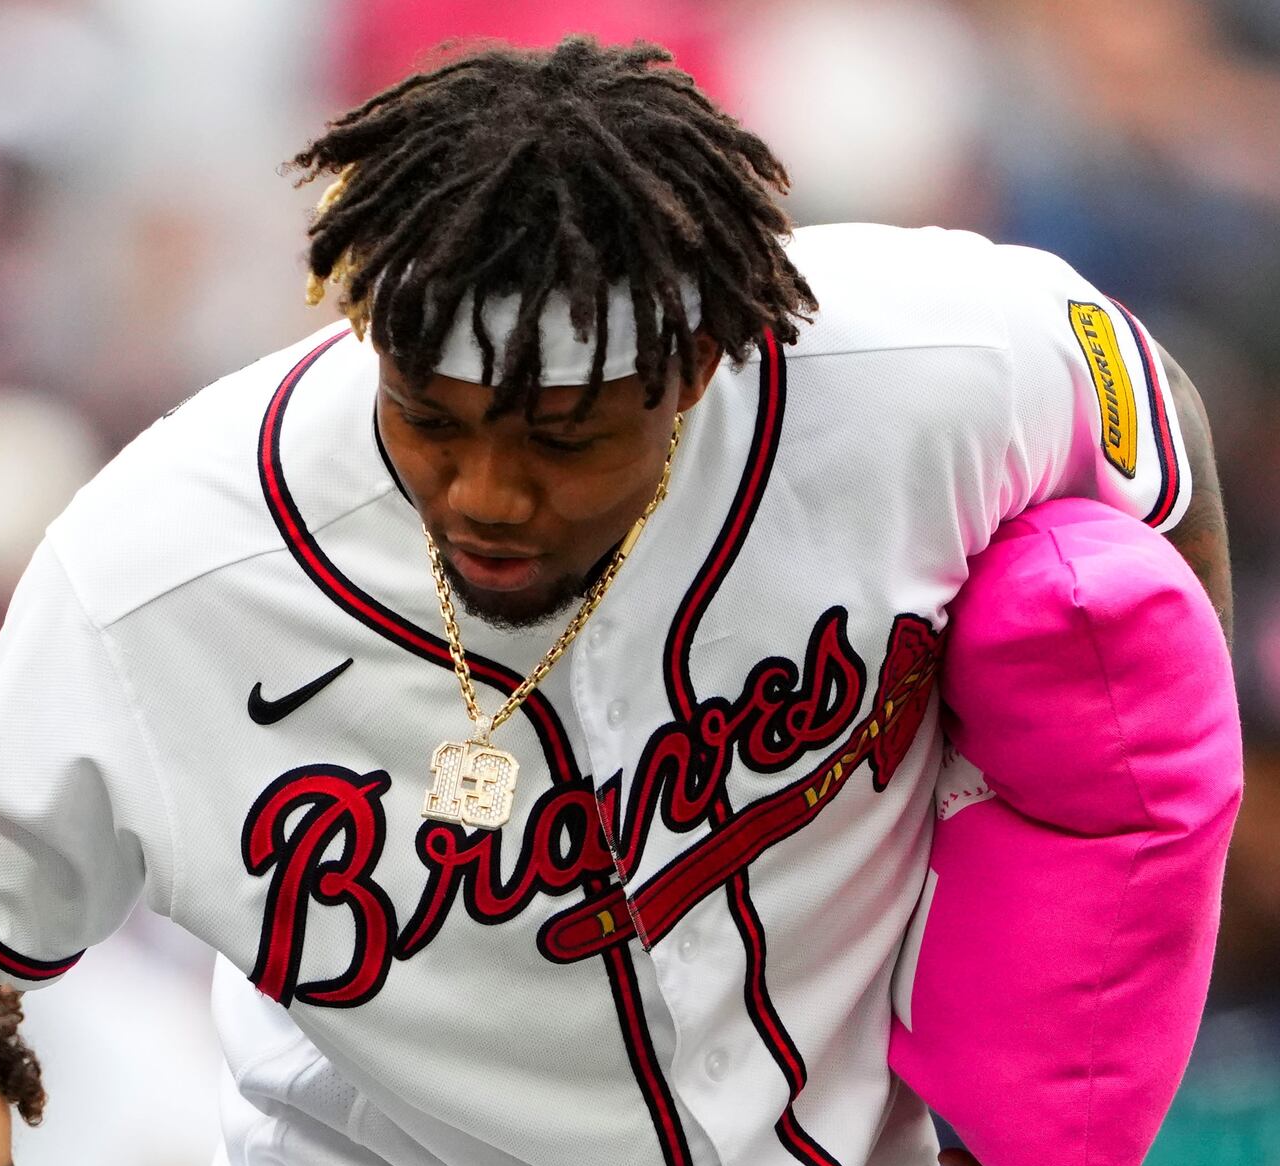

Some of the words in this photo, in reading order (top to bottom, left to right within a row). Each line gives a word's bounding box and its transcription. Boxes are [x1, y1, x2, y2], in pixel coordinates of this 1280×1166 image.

[1079, 310, 1122, 449] QUIKRETE
[242, 605, 867, 1009] Braves
[421, 741, 520, 831] 13
